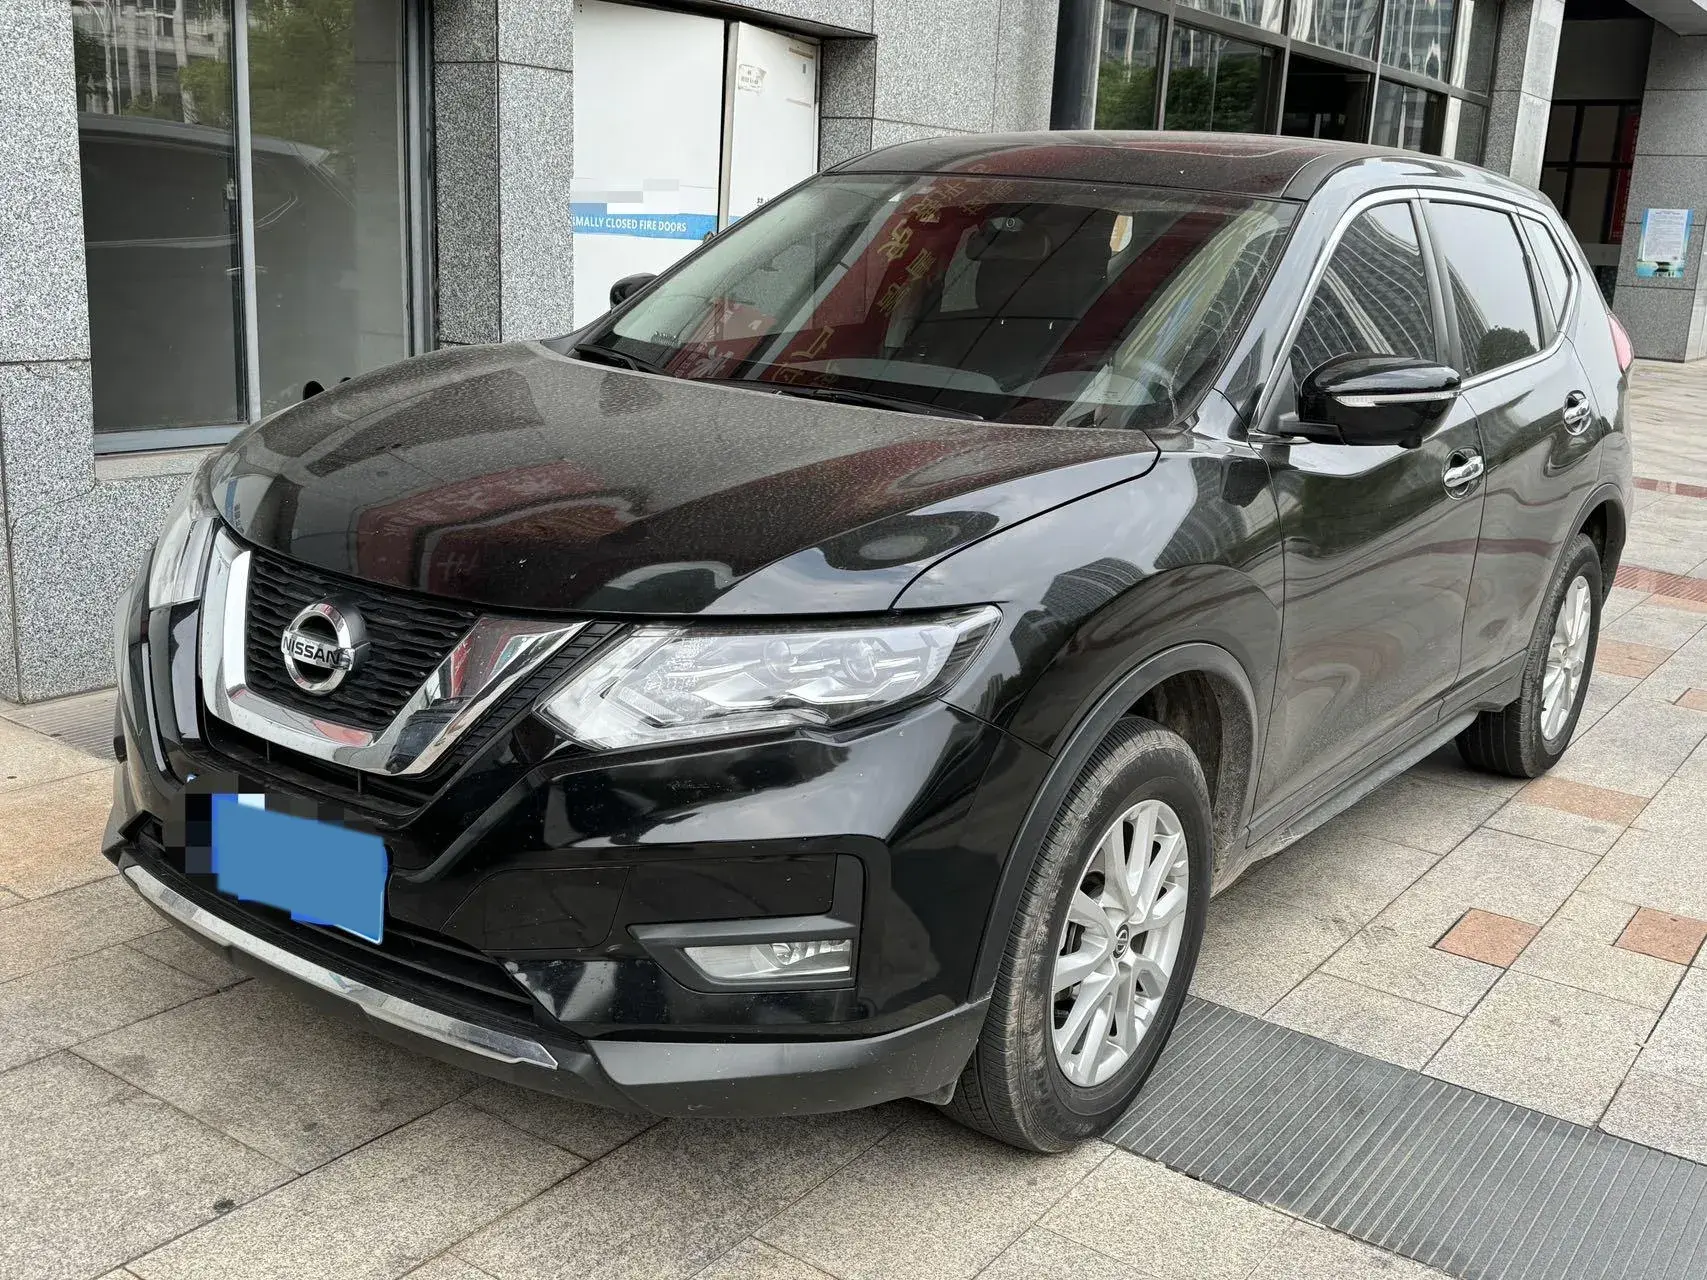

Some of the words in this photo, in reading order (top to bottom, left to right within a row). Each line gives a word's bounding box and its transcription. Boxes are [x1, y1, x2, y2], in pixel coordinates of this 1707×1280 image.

[605, 217, 638, 230] CLOSED
[640, 219, 657, 231] FIRE
[659, 221, 687, 233] DOORS
[282, 635, 341, 665] NISSAN
